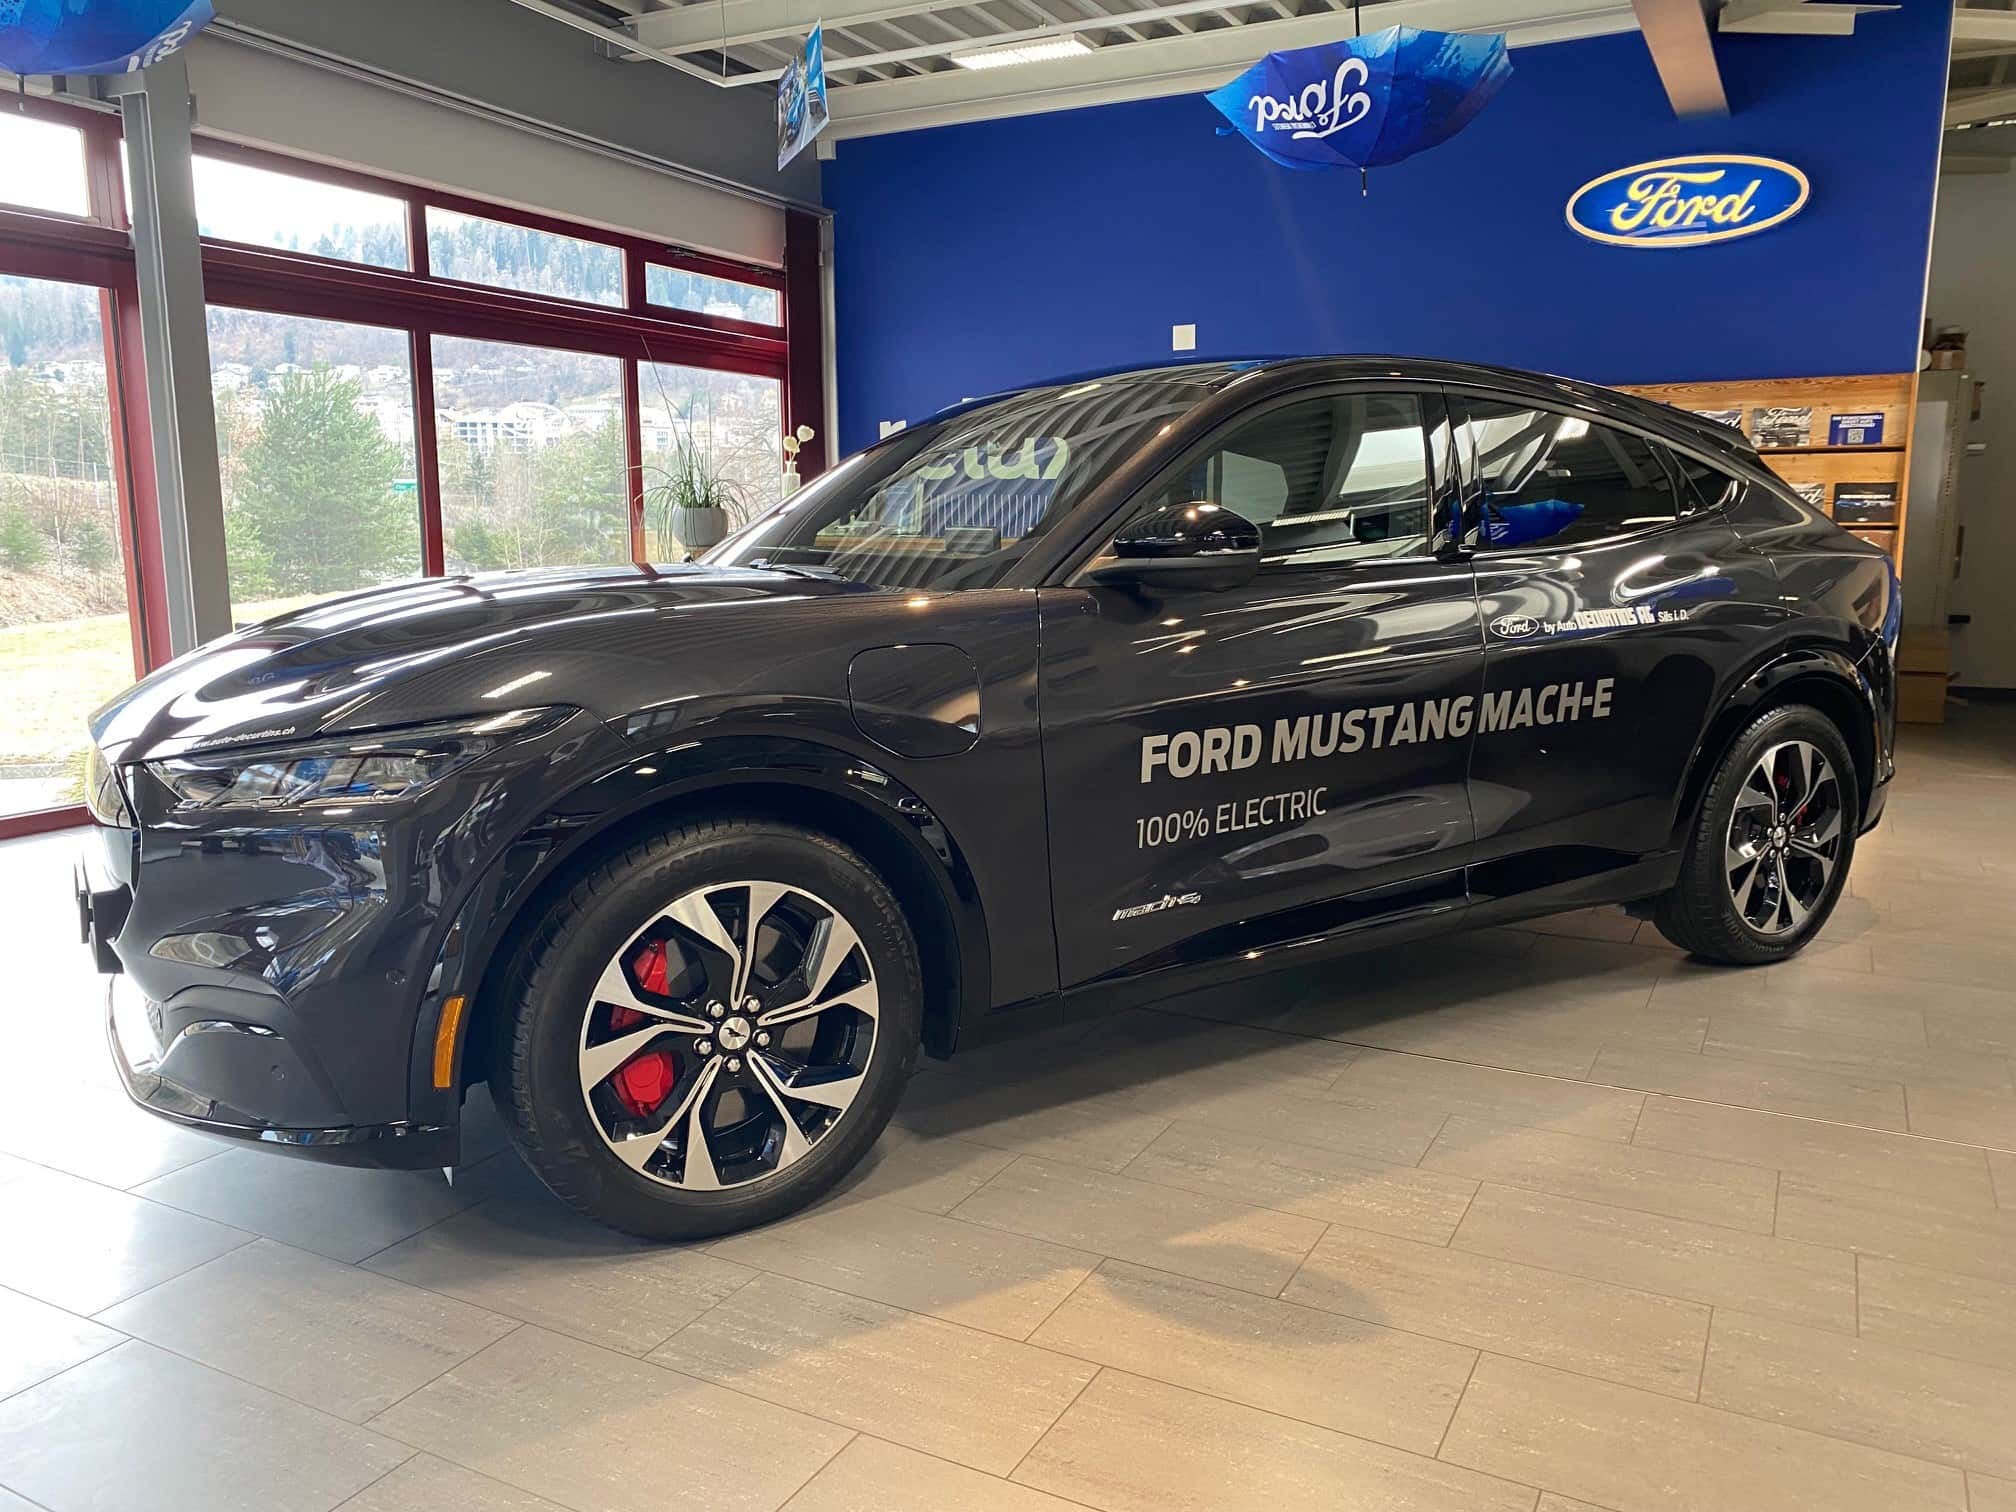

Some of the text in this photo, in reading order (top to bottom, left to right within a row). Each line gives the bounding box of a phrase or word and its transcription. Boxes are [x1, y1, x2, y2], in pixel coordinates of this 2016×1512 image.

[1248, 57, 1371, 140] Ford
[1611, 168, 1763, 232] Ford
[1500, 617, 1531, 635] Ford
[1542, 620, 1556, 635] by
[1556, 619, 1578, 632] Auto
[1635, 605, 1656, 625] AG
[1141, 678, 1615, 784] FORD MUSTANG MACH-E
[1136, 787, 1328, 849] 100% ELECTRIC
